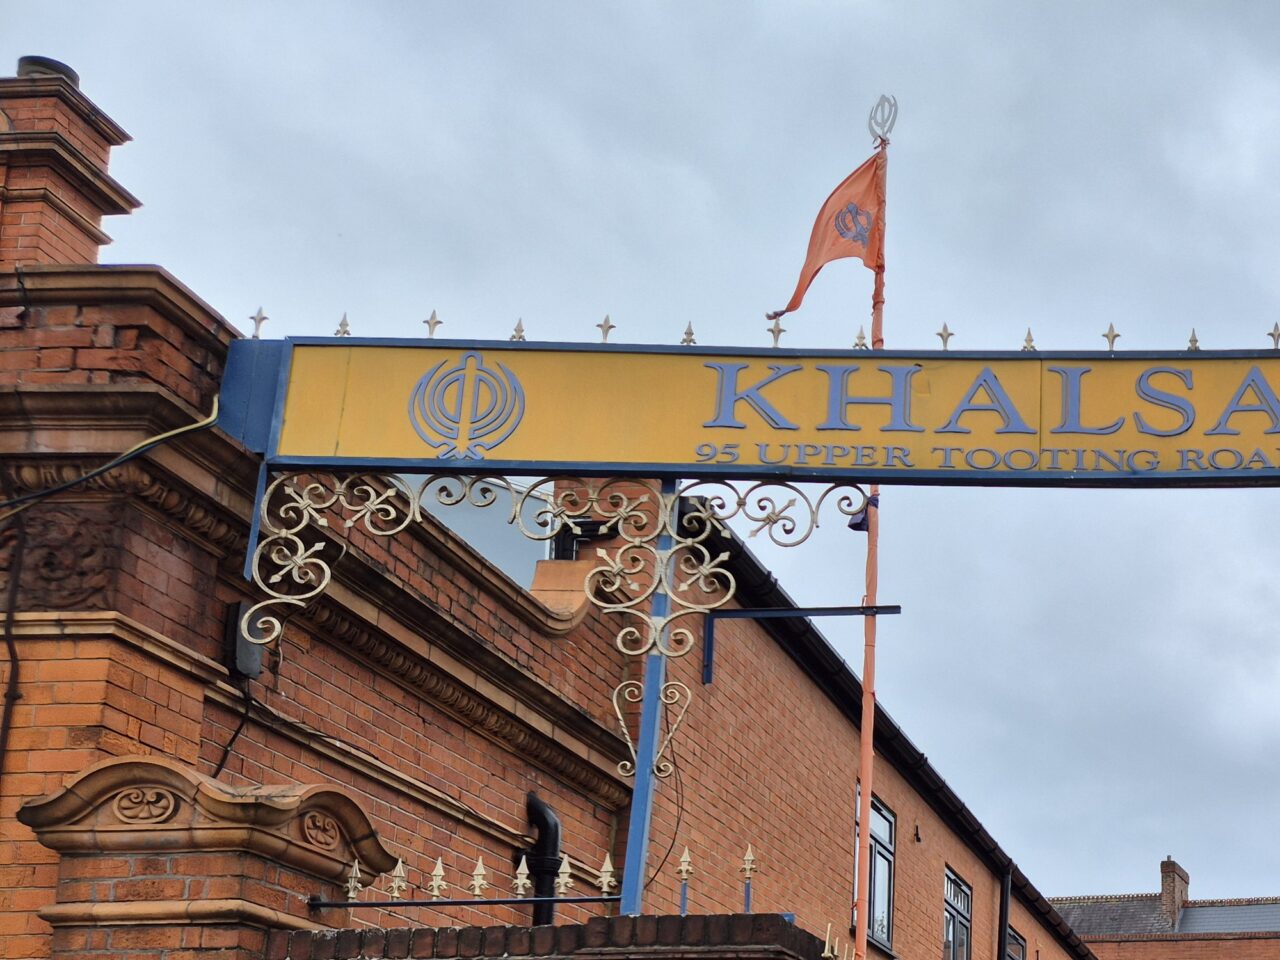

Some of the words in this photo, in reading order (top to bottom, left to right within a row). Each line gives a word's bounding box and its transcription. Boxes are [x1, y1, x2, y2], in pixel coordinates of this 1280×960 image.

[696, 443, 741, 464] 95
[755, 443, 917, 468] UPPER
[932, 446, 1160, 472] TOOTING
